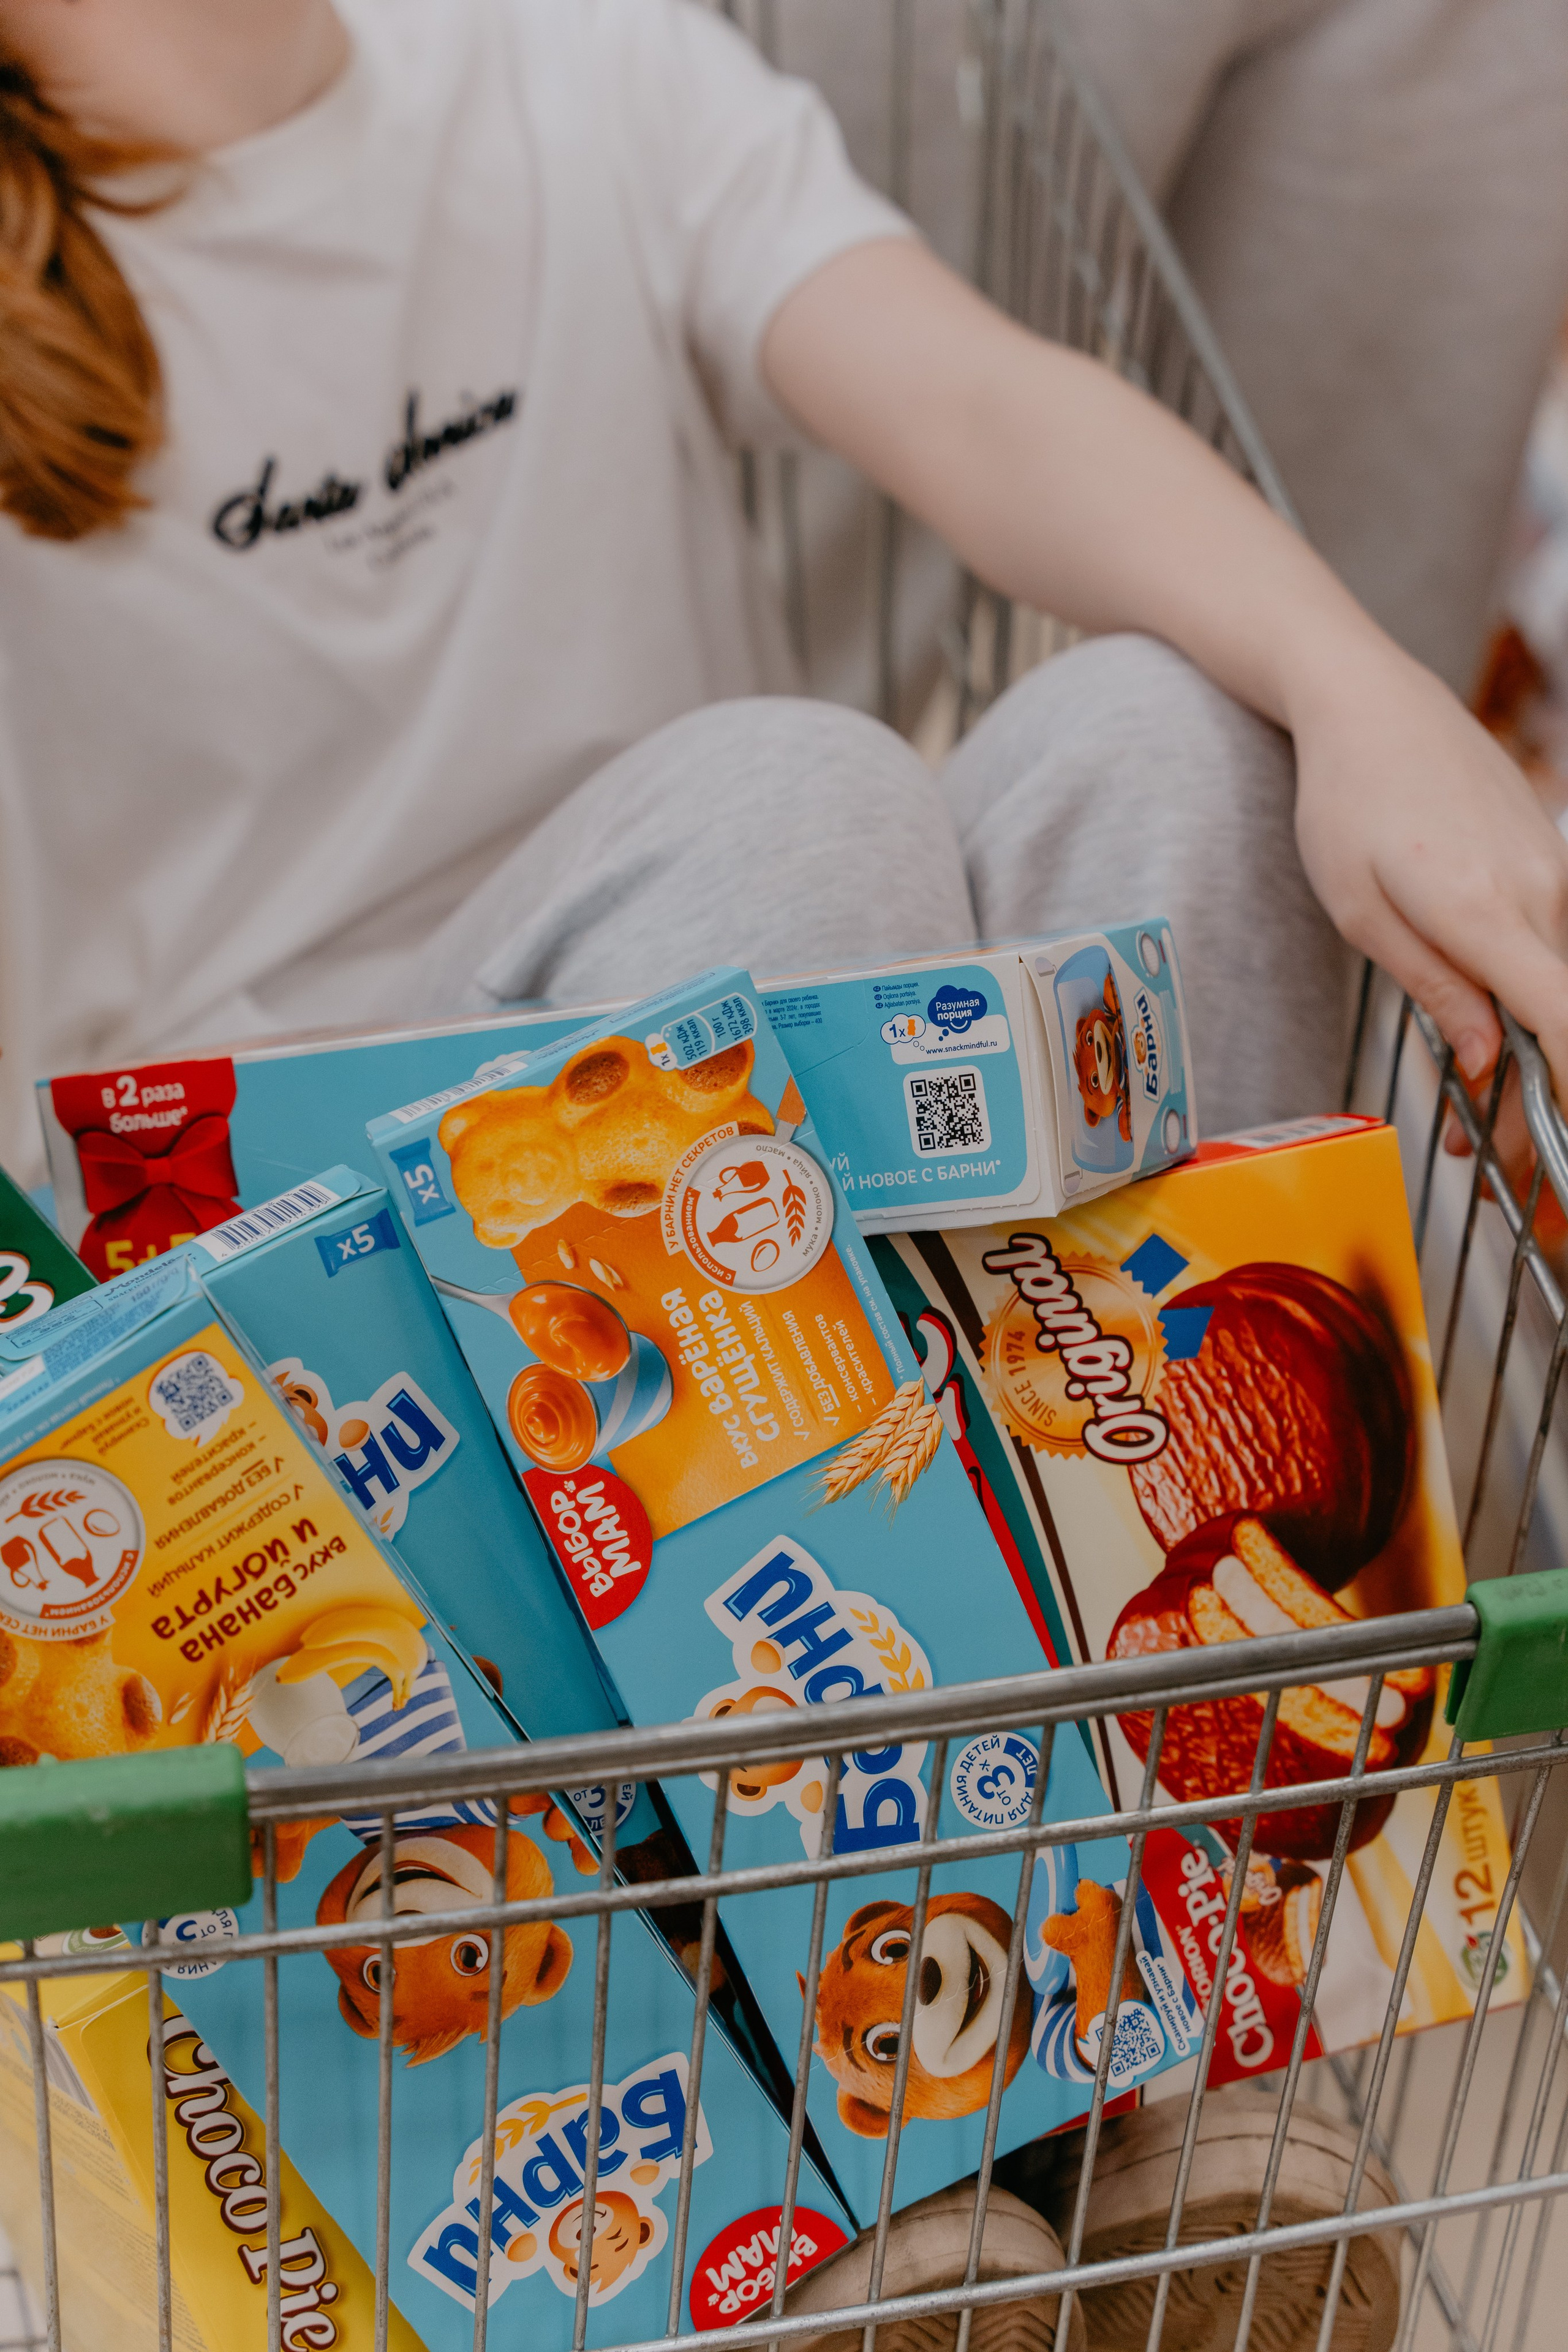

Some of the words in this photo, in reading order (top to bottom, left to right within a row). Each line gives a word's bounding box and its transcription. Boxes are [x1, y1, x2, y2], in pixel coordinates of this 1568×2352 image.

[719, 1001, 734, 1019] кДж
[733, 997, 747, 1017] ккал
[936, 998, 979, 1011] Разумная
[937, 1009, 972, 1022] порция
[673, 1025, 690, 1044] кДж
[687, 1019, 701, 1038] ккал
[713, 1022, 726, 1037] 100
[726, 1017, 743, 1039] 1672
[739, 1017, 753, 1033] 398
[682, 1044, 696, 1060] 502
[694, 1039, 708, 1055] 119
[925, 1040, 997, 1055] www.snackmindful.ru
[1135, 994, 1158, 1096] Барни
[116, 1075, 139, 1107] 2
[141, 1082, 186, 1107] раза
[682, 1126, 734, 1168] СЕКРЕТОВ
[756, 1145, 785, 1158] масло
[668, 1168, 685, 1194] НЕТ
[793, 1158, 812, 1178] яйца
[859, 1170, 918, 1189] НОВОЕ
[921, 1168, 933, 1182] С
[665, 1195, 675, 1238] БАРНИ
[813, 1186, 823, 1224] молоко
[668, 1240, 679, 1249] У
[802, 1233, 818, 1257] мука
[845, 1243, 868, 1285] упаковке.
[864, 1286, 871, 1295] на
[867, 1297, 878, 1311] см.
[738, 1300, 774, 1362] КАЛЬЦИЙ
[874, 1312, 889, 1338] состав
[783, 1310, 829, 1390] ДОБАВЛЕНИЯ
[815, 1313, 858, 1402] консервантов
[832, 1319, 875, 1395] красителей
[886, 1340, 904, 1373] Полный
[983, 1234, 1167, 1461] Original
[1006, 1330, 1027, 1376] 1974
[766, 1361, 805, 1428] СОДЕРЖИТ
[818, 1389, 835, 1412] БЕЗ
[1014, 1379, 1057, 1427] SINCE
[170, 1427, 247, 1485] красителей
[168, 1444, 258, 1506] консервантов
[244, 1464, 273, 1487] БЕЗ
[154, 1482, 246, 1551] ДОБАВЛЕНИЯ
[216, 1493, 292, 1551] СОДЕРЖИТ
[291, 1517, 320, 1539] и
[576, 1481, 642, 1578] МАМ
[147, 1539, 216, 1598] КАЛЬЦИЙ
[21, 1621, 49, 1637] НЕТ
[50, 1618, 97, 1638] БАРНИ
[960, 1735, 1000, 1773] ДЕТЕЙ
[997, 1790, 1011, 1806] ОТ
[1016, 1749, 1038, 1775] ЛЕТ
[957, 1775, 1004, 1825] ПИТАНИЯ
[1008, 1792, 1033, 1821] ДЛЯ
[1454, 1863, 1495, 1926] 12
[1139, 1956, 1163, 1994] узнавай
[1160, 2003, 1186, 2051] Сканируй
[1175, 2004, 1190, 2032] новое
[147, 2014, 272, 2236] Choco
[236, 2226, 339, 2352] Pie
[422, 2068, 698, 2299] Барни
